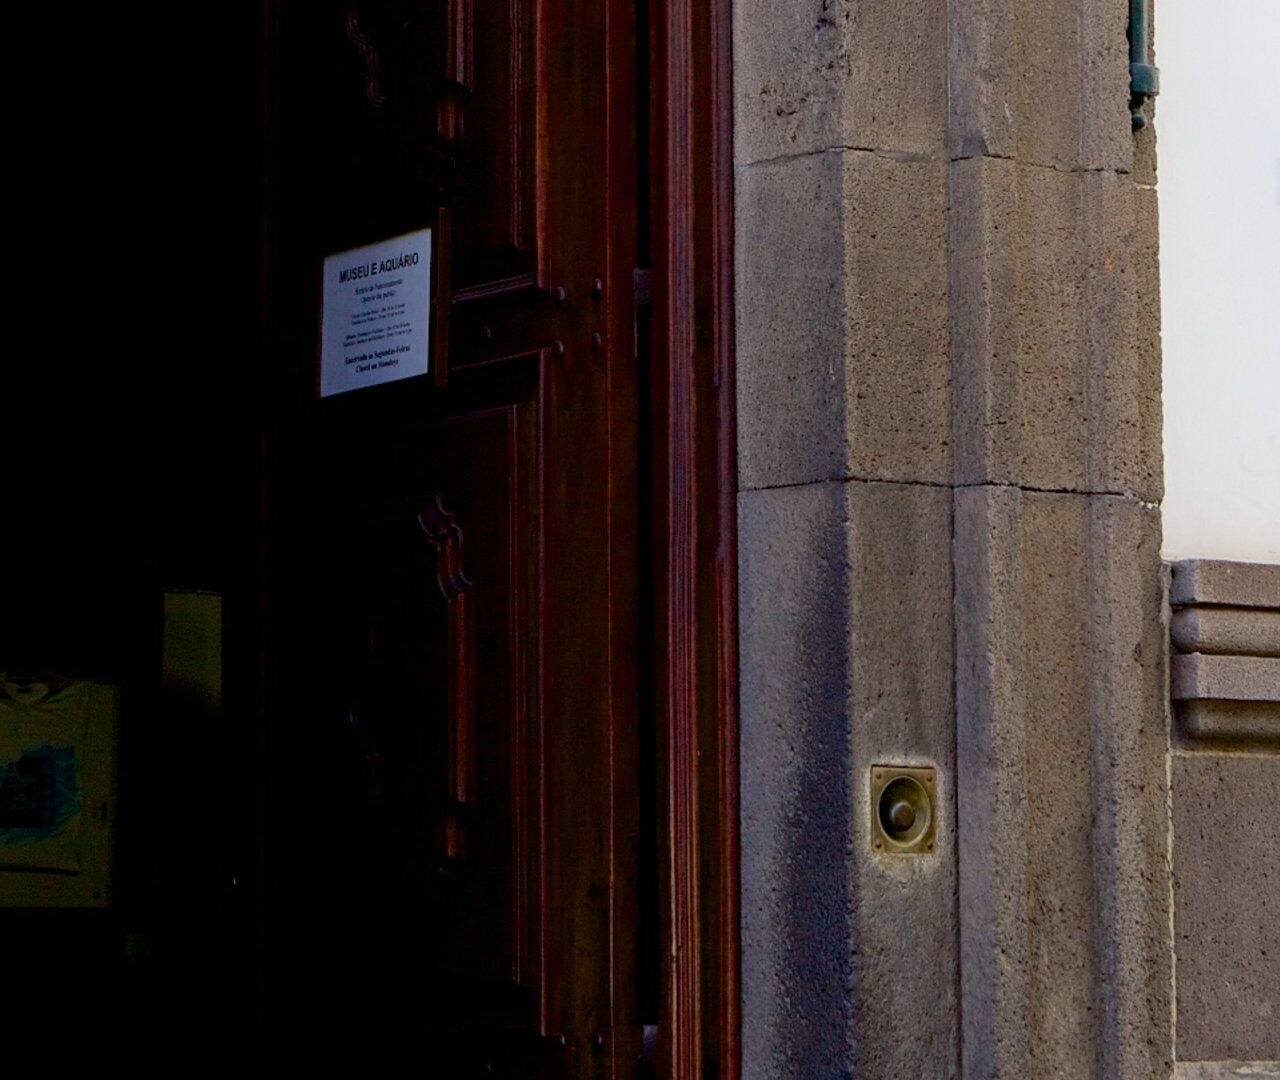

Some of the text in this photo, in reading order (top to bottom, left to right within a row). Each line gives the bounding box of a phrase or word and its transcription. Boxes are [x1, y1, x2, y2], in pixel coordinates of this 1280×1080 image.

[339, 252, 419, 283] MUSEU E AQUÁRIO
